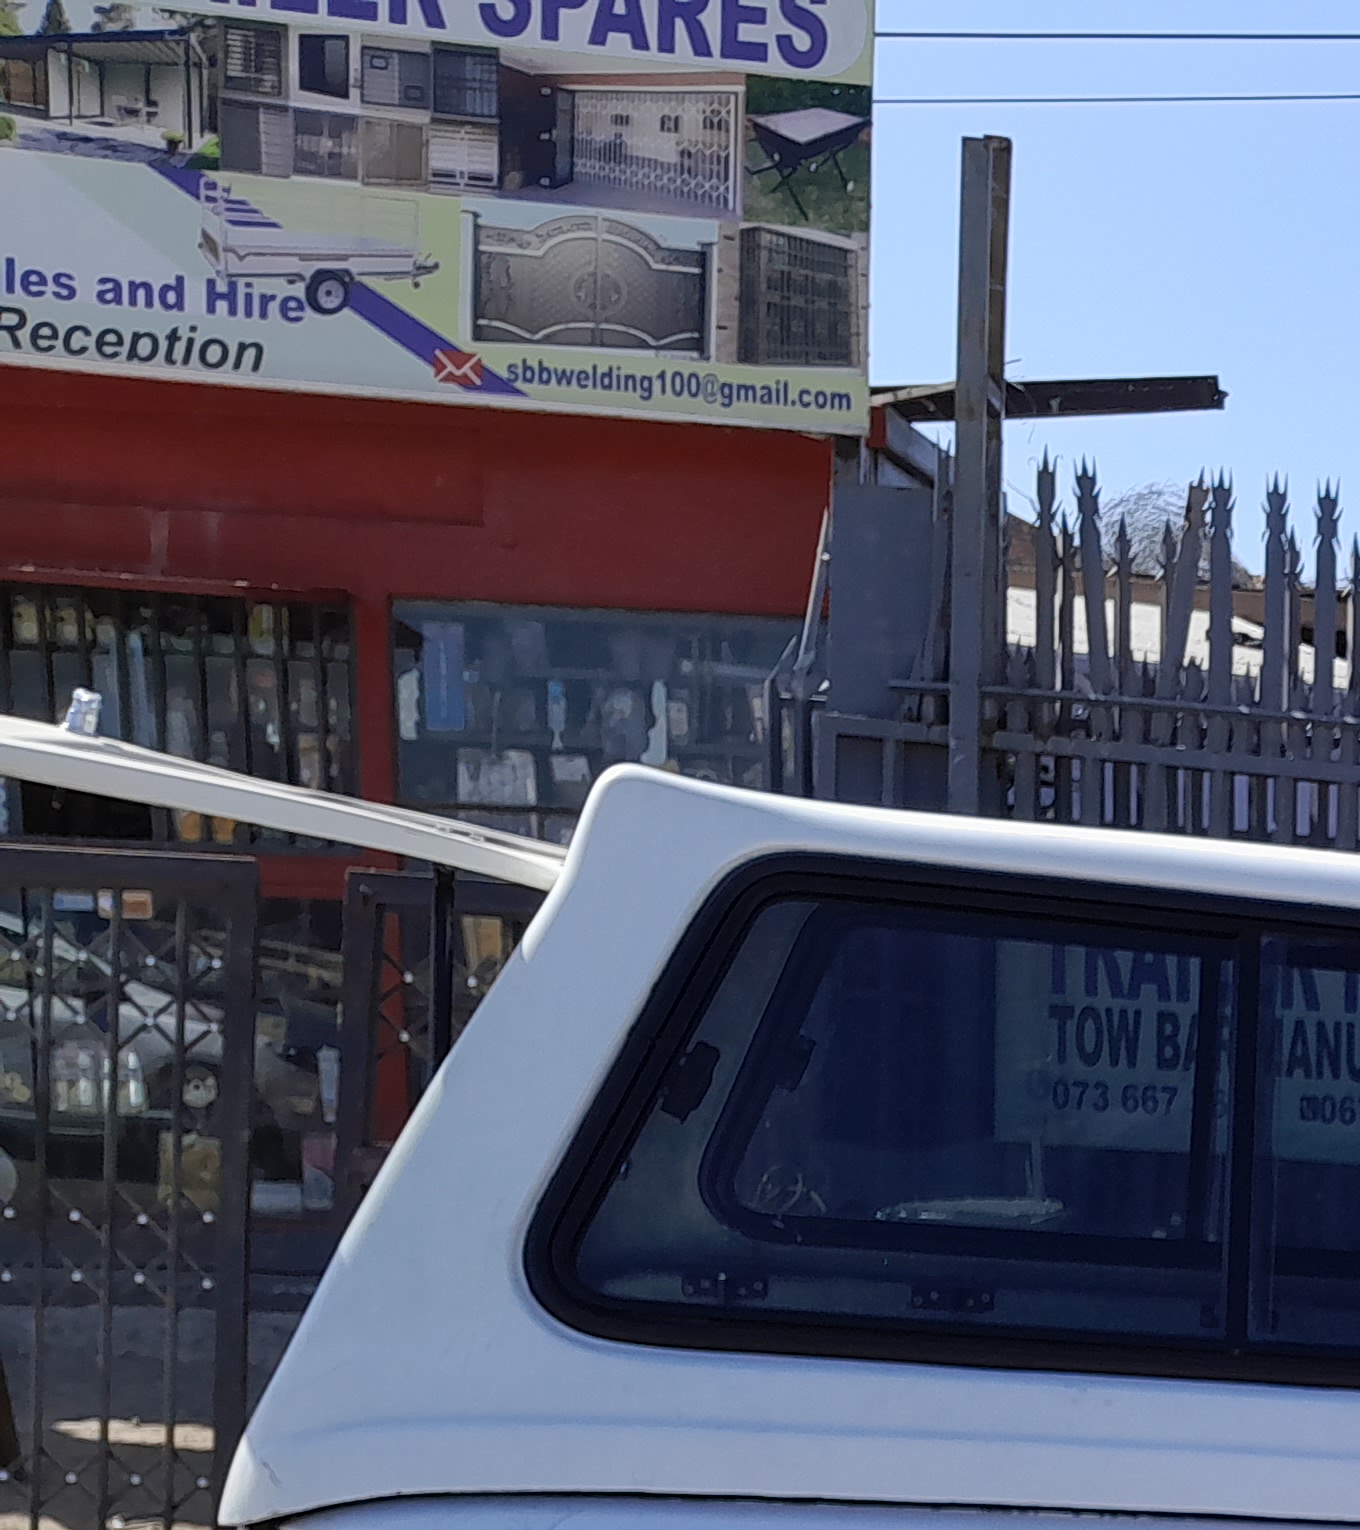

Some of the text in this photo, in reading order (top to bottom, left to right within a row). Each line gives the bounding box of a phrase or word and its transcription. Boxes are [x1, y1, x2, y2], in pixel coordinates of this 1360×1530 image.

[95, 274, 187, 313] and
[205, 277, 307, 324] Hire
[0, 305, 266, 374] Reception
[505, 357, 854, 412] sbbwelding100@gmail.com
[1047, 1003, 1143, 1069] TOW
[1051, 1079, 1110, 1113] 073
[1121, 1083, 1179, 1117] 667
